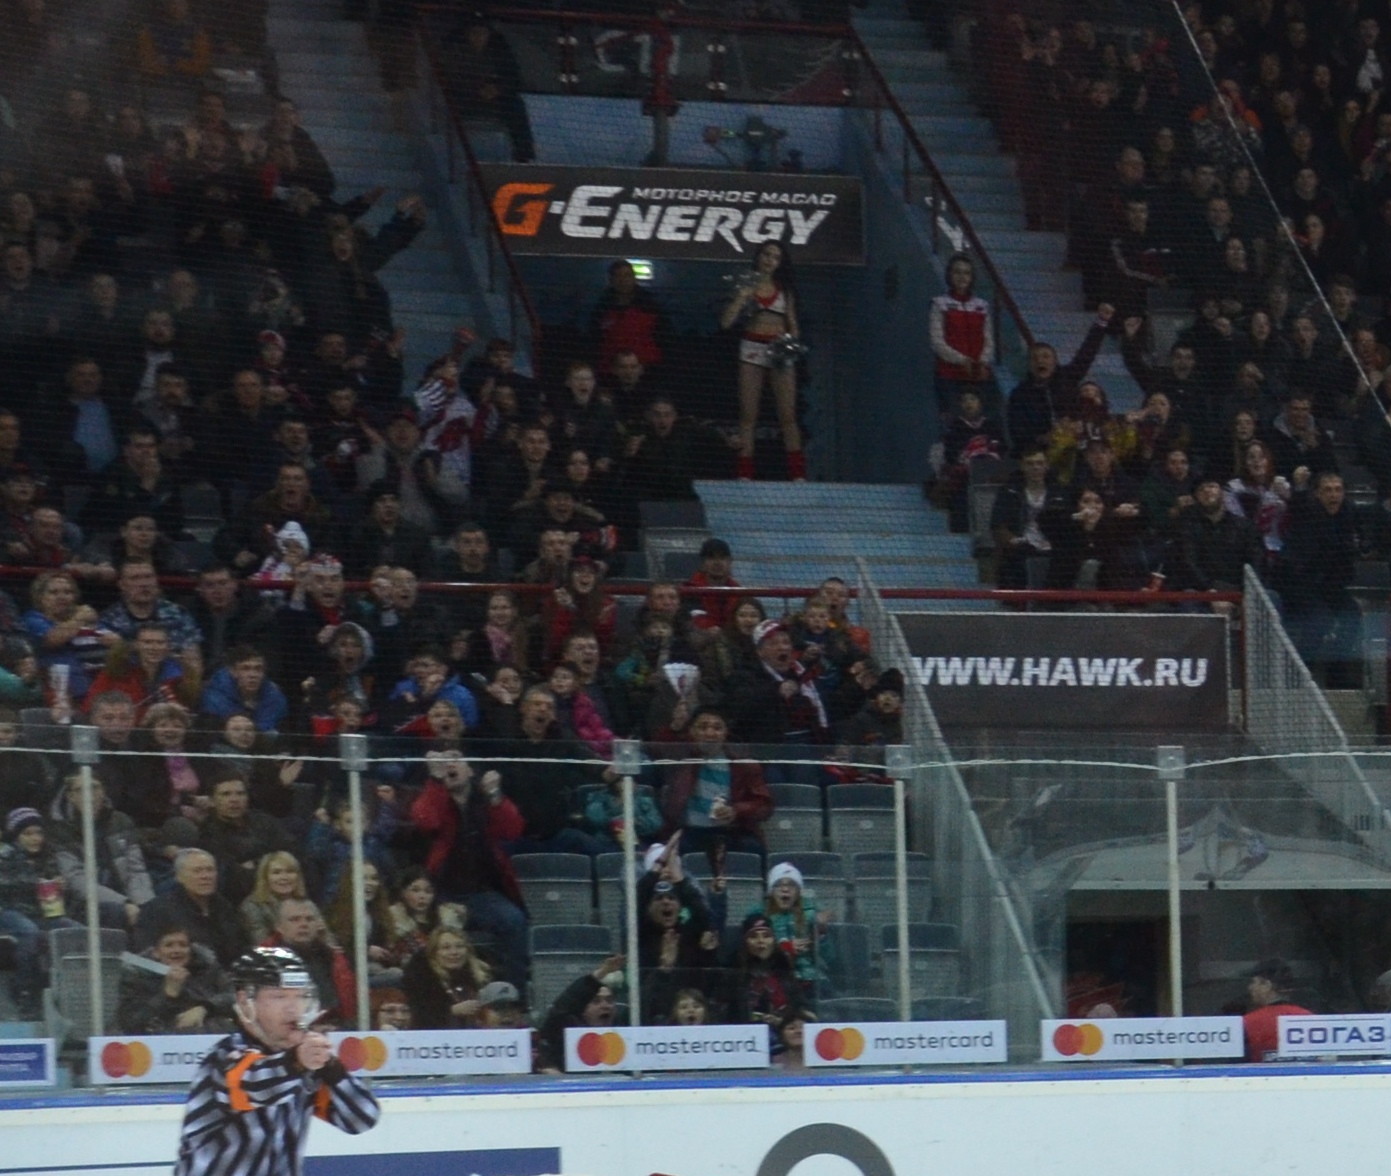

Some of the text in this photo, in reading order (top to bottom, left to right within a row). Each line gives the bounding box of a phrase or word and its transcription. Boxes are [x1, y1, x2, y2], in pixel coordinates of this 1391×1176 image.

[873, 1031, 994, 1051] mastercard
[1113, 1027, 1231, 1046] mastercard
[1286, 1026, 1386, 1045] СОГАЗ
[397, 1040, 519, 1060] mastercard
[636, 1036, 758, 1056] mastercard
